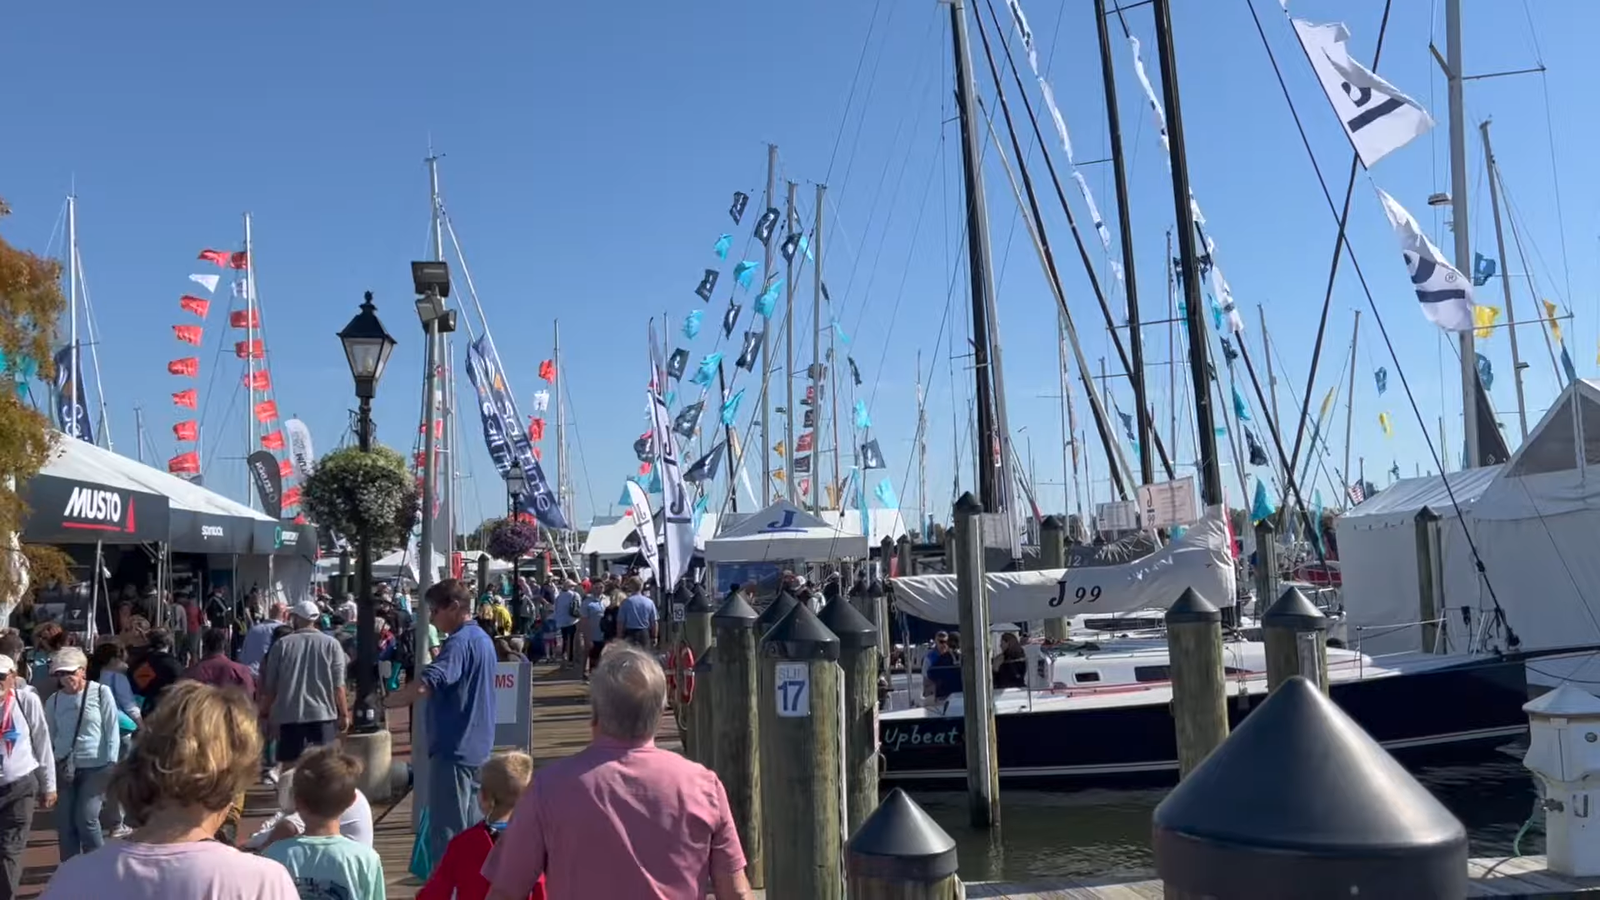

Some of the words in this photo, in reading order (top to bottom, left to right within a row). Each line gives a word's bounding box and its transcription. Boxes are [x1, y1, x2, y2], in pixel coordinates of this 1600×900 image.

[63, 486, 121, 523] MUSTO
[1048, 581, 1067, 608] J
[1073, 585, 1102, 605] 99
[777, 680, 806, 712] 17
[884, 724, 960, 752] Upbeat
